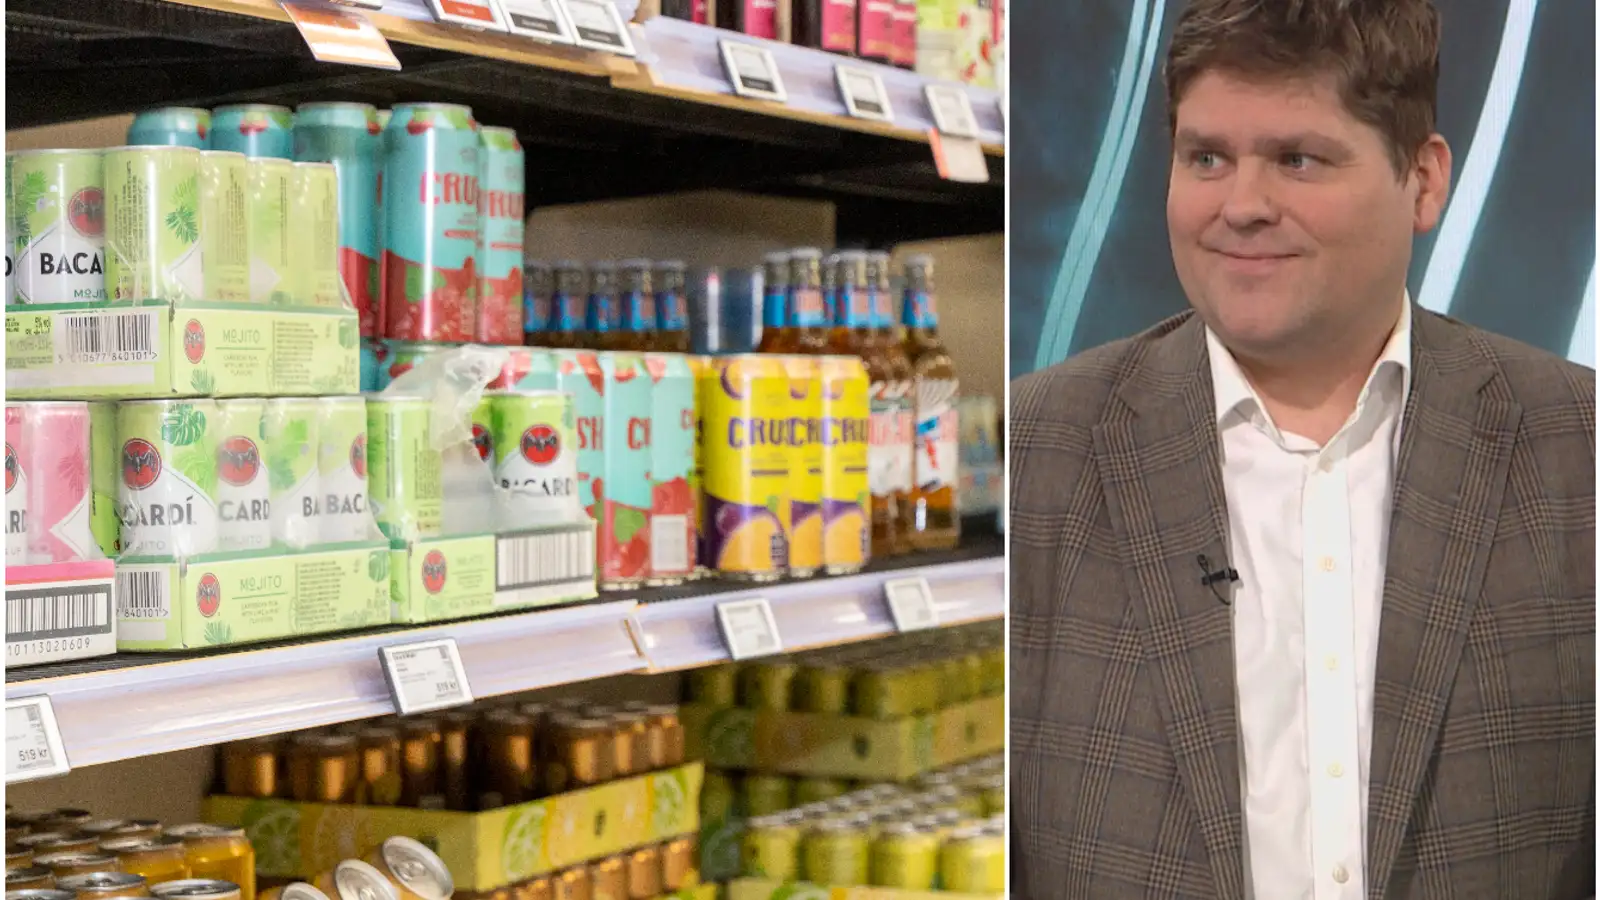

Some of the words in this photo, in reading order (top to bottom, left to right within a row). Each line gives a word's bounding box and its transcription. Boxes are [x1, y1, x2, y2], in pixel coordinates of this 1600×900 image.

[40, 252, 102, 275] BACA
[19, 749, 36, 761] 519
[39, 747, 47, 758] kr
